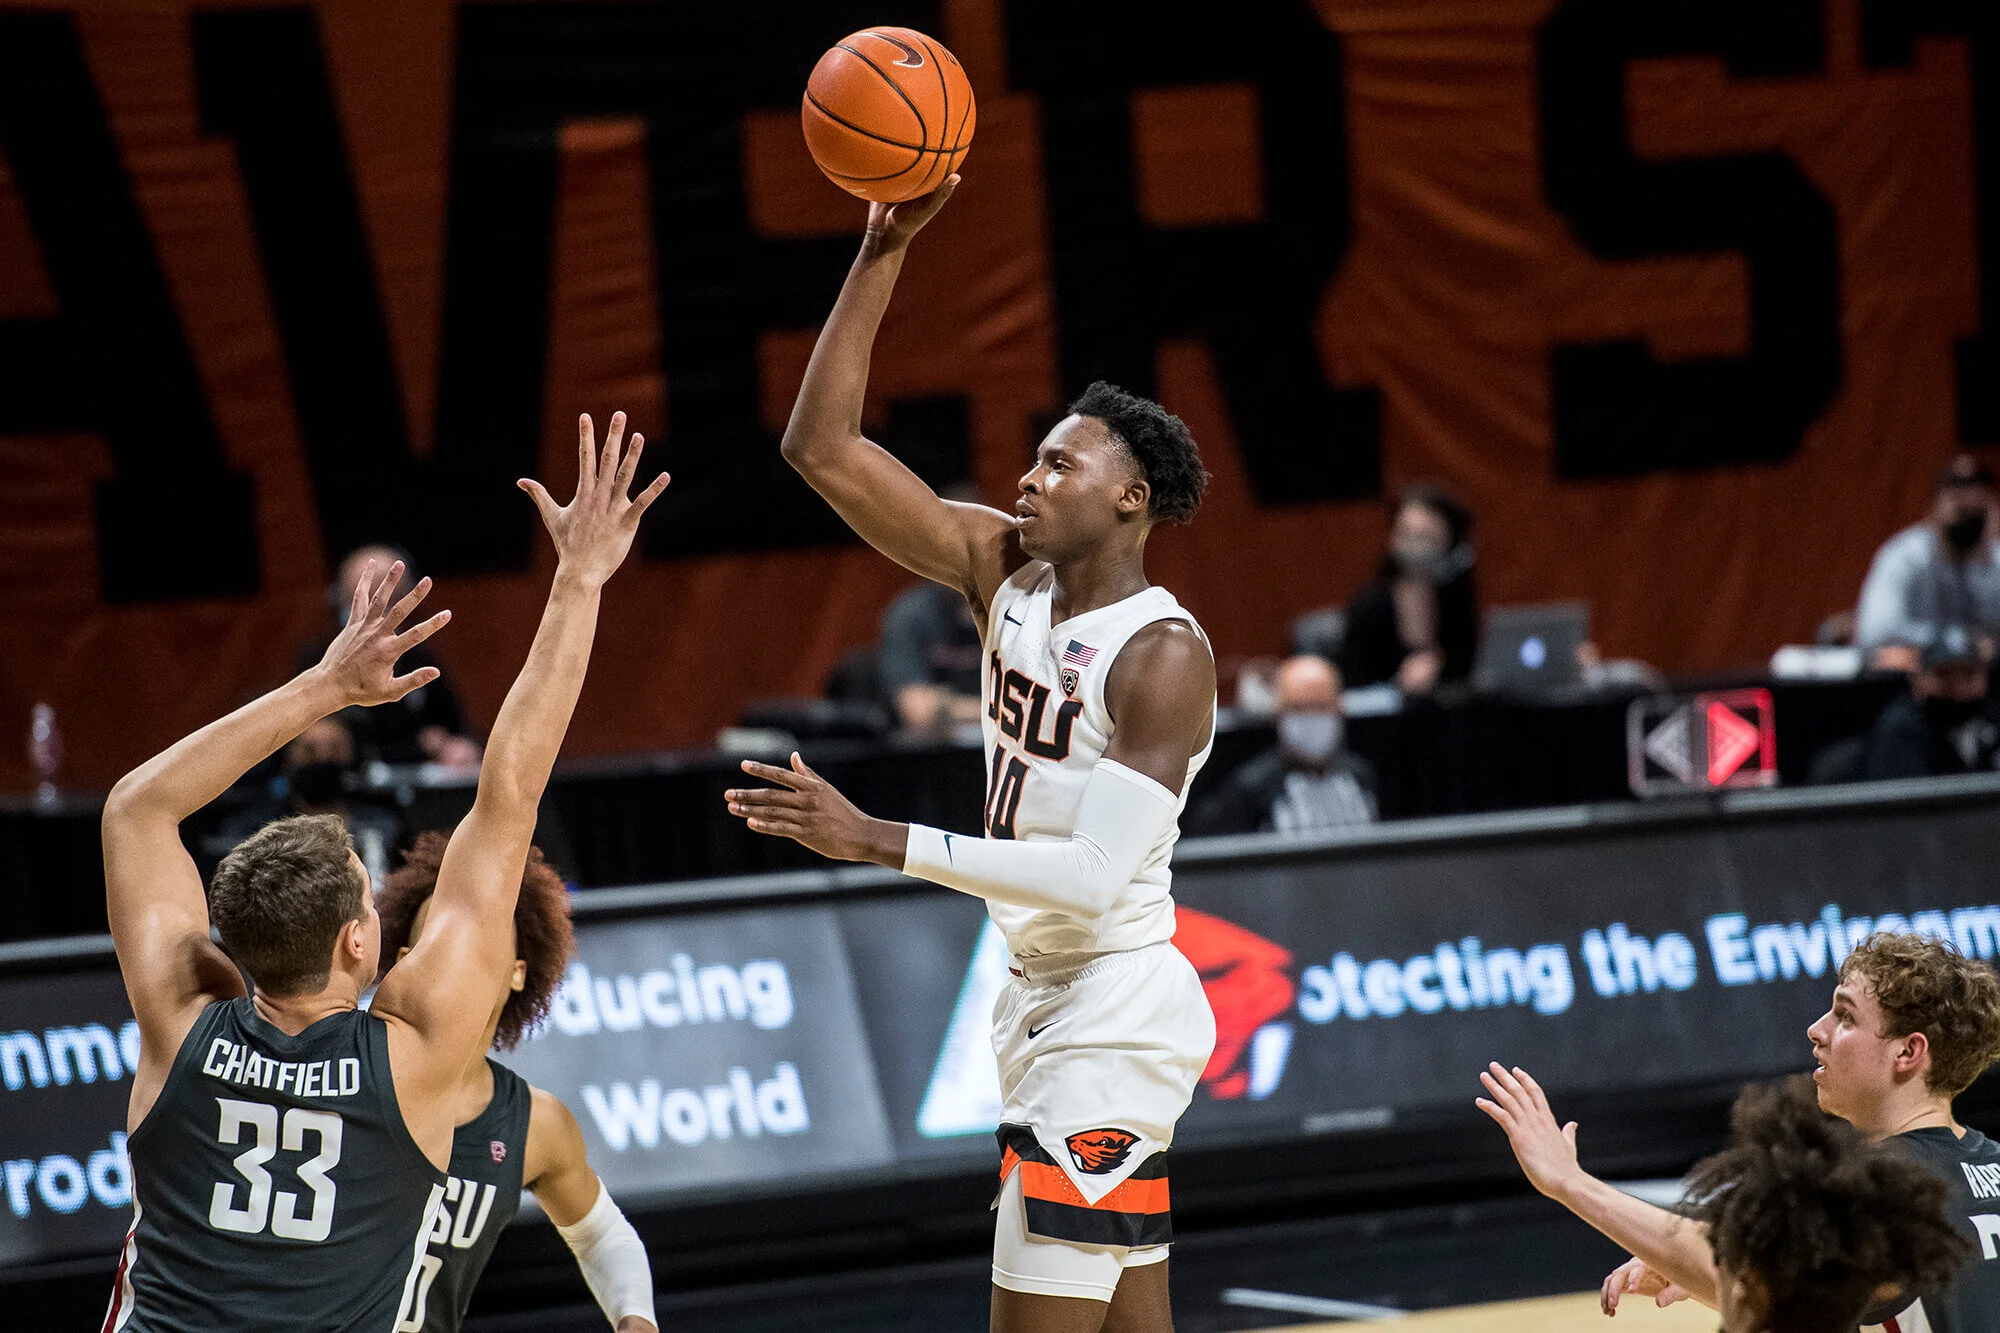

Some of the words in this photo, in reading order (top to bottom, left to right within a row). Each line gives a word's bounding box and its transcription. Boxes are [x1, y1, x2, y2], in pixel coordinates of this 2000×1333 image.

[984, 742, 1031, 840] 10
[524, 952, 796, 1038] ducing
[1581, 922, 1698, 998] the
[202, 1037, 361, 1097] CHATFIELD
[579, 1060, 811, 1152] World
[0, 1129, 133, 1219] rod
[208, 1096, 344, 1242] 33
